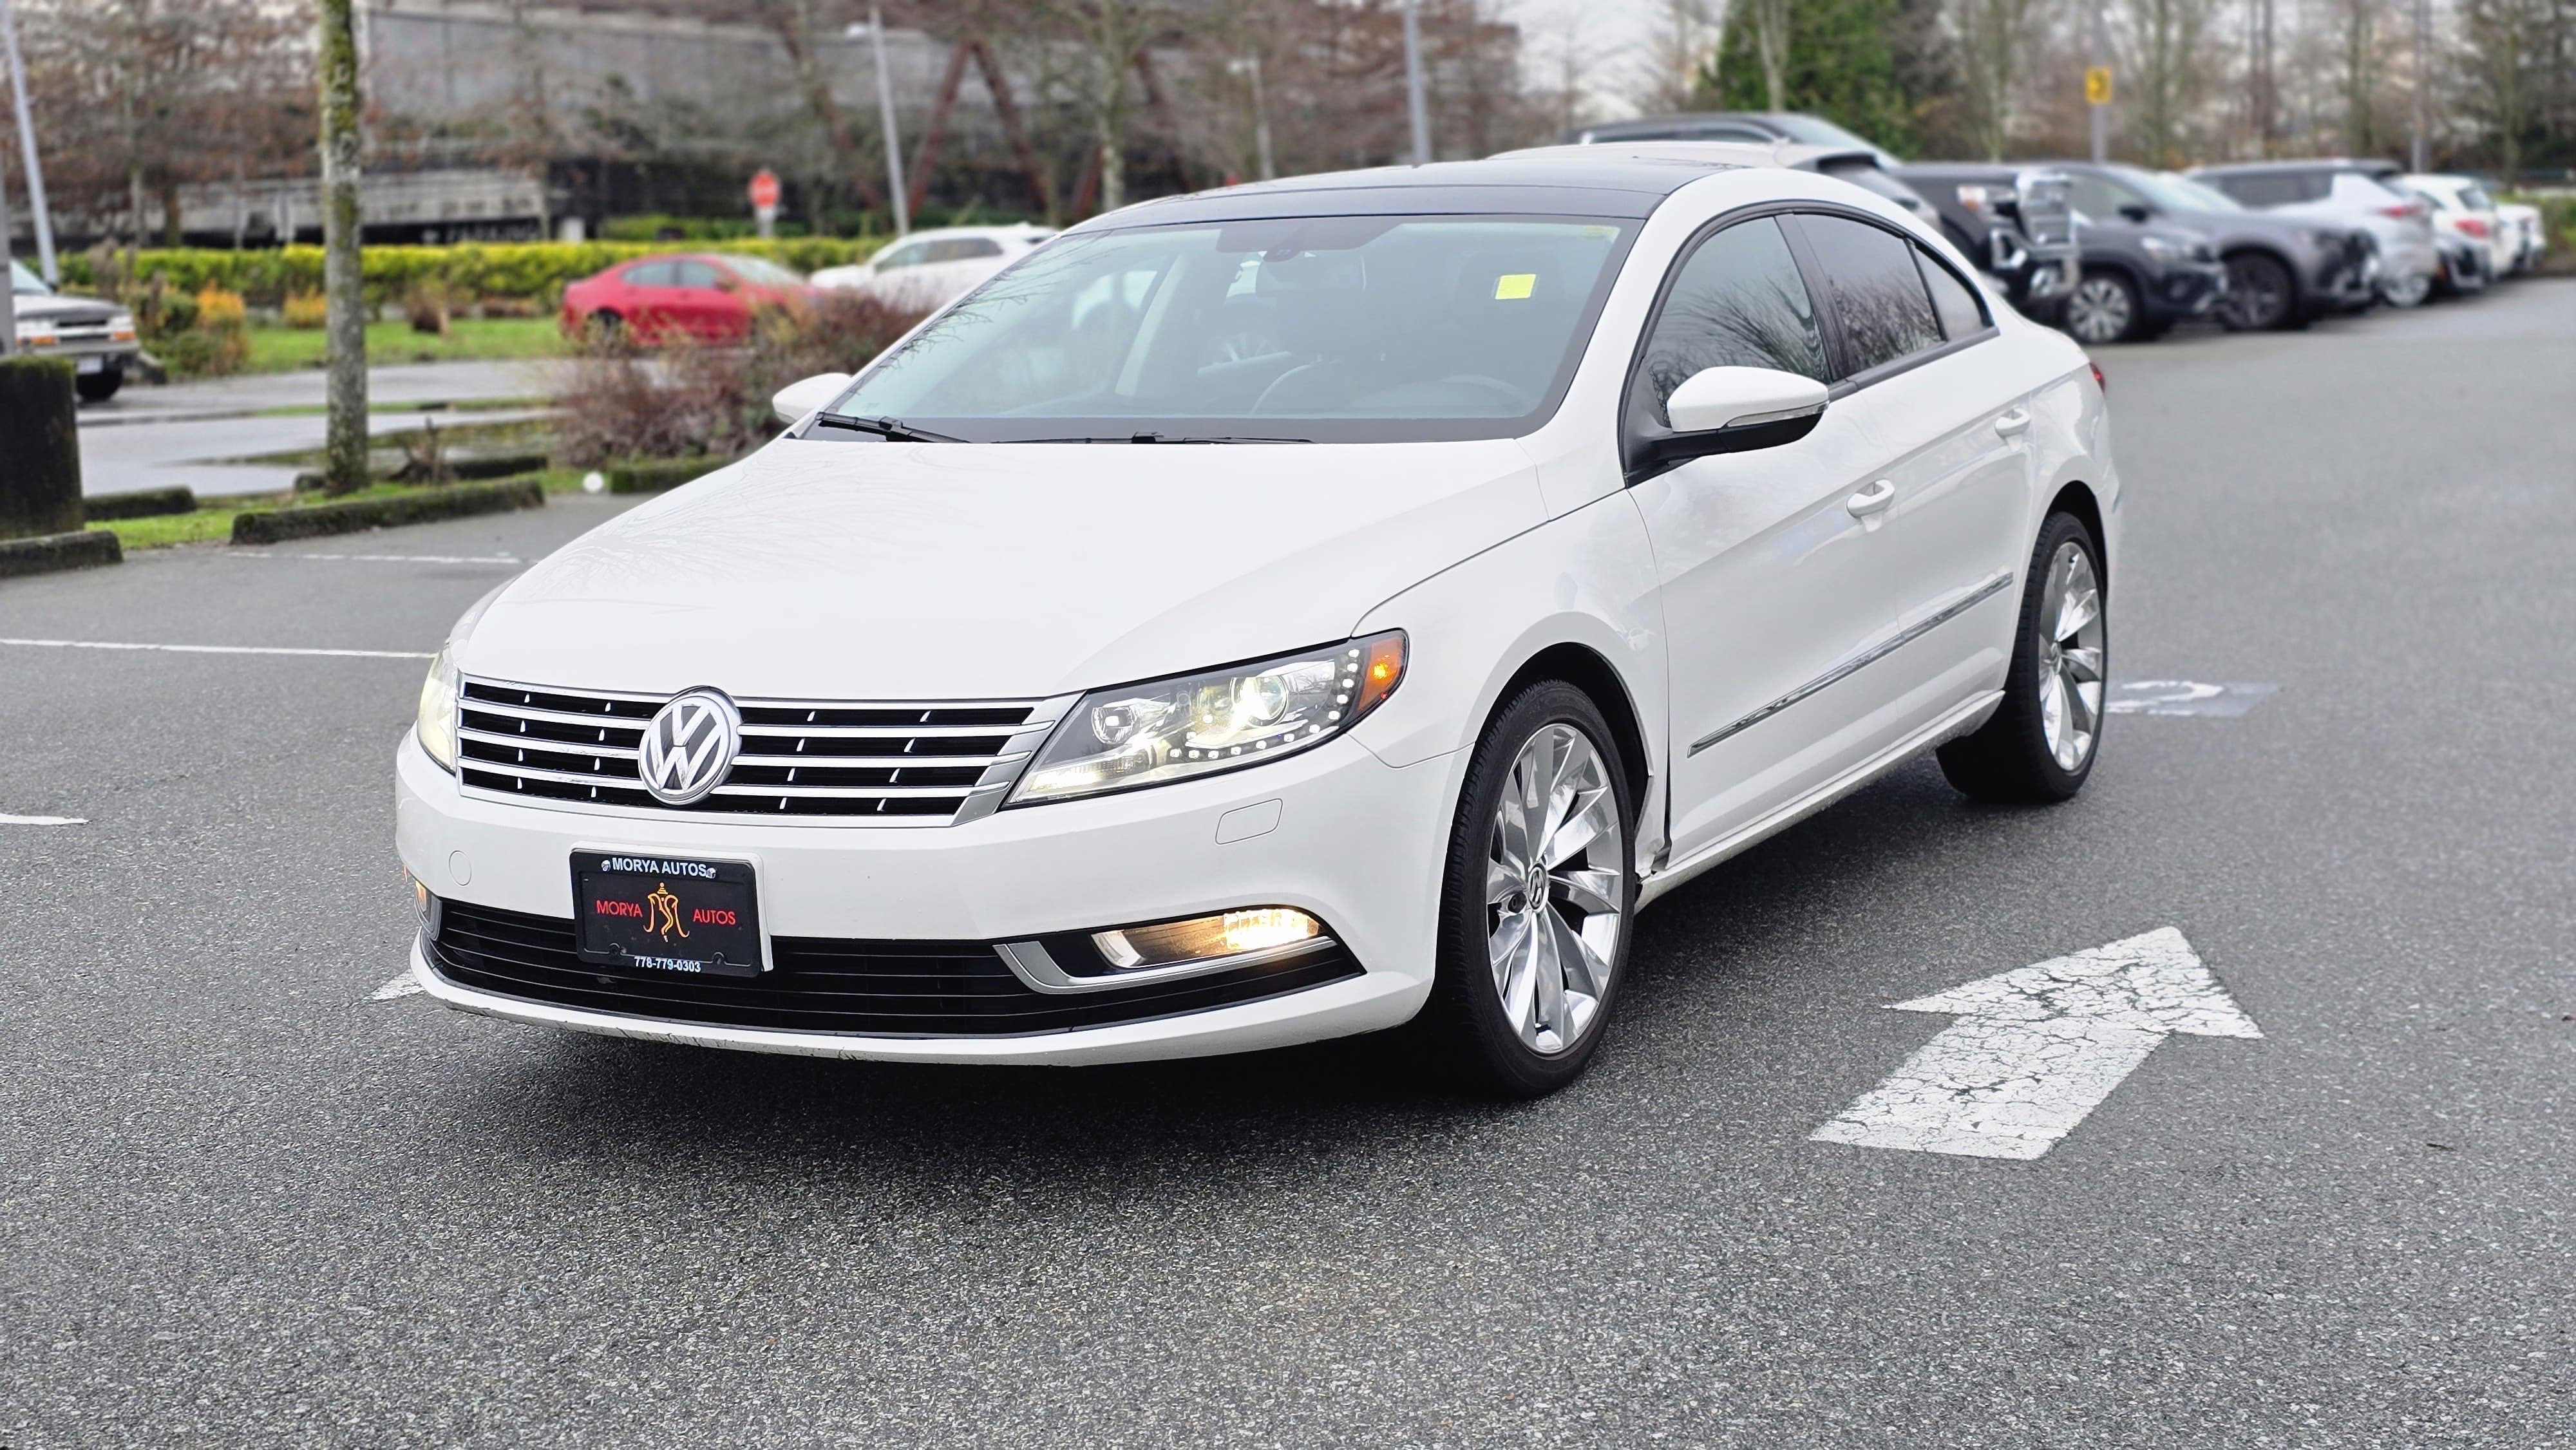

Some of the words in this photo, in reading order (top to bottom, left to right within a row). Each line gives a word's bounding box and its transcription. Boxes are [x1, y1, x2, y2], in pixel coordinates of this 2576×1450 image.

[645, 699, 725, 796] VW
[612, 857, 659, 874] MORYA
[661, 861, 706, 876] AUTOS
[596, 899, 643, 918] MORYA
[692, 909, 736, 925] AUTOS
[634, 956, 701, 973] 778-779-0303
